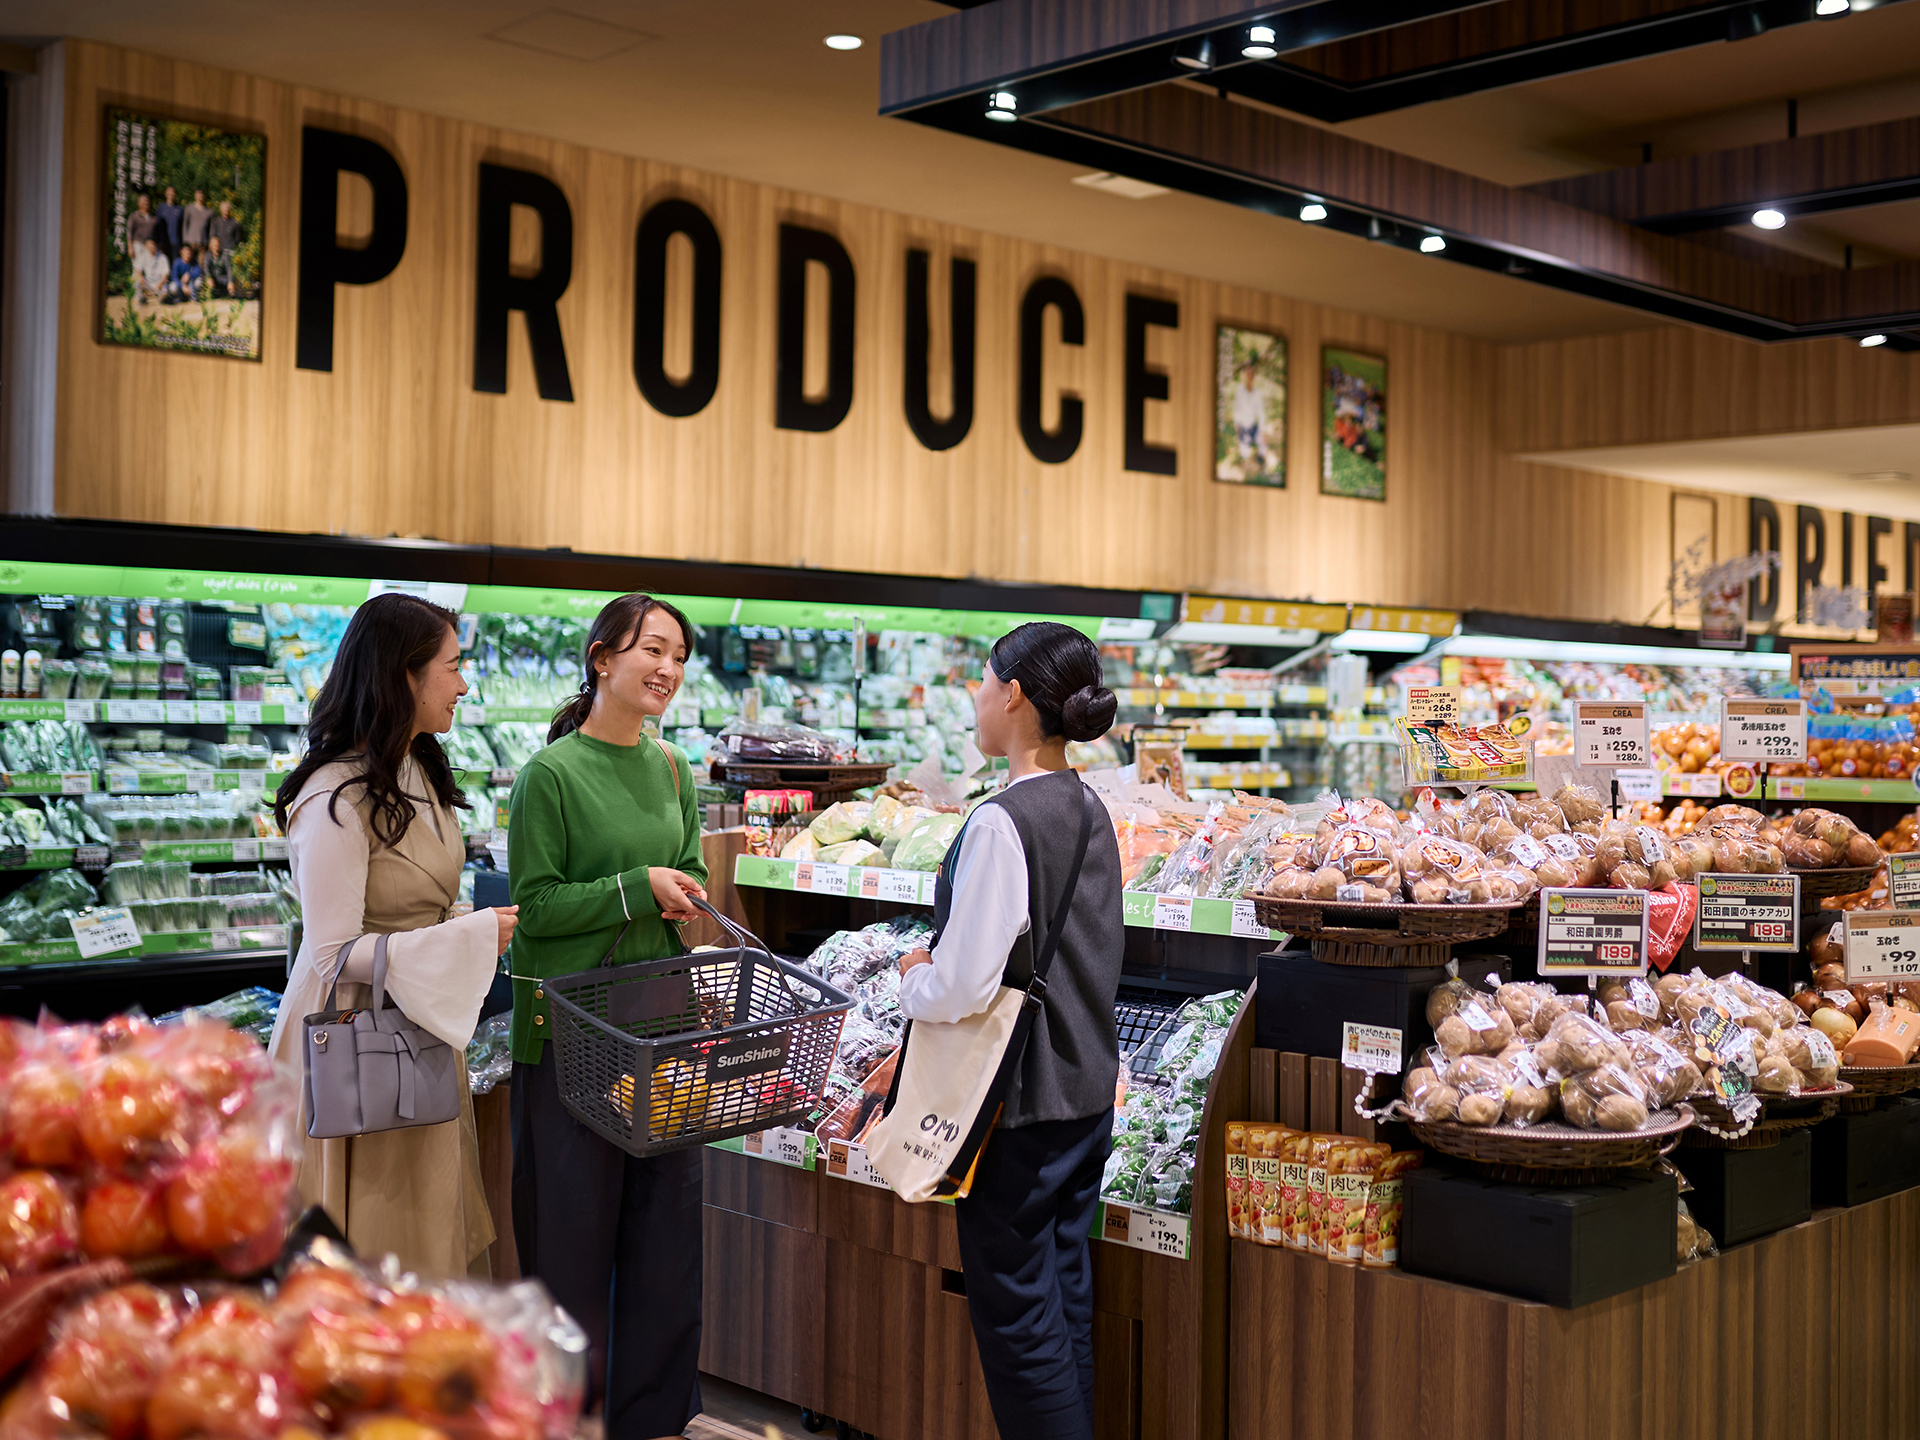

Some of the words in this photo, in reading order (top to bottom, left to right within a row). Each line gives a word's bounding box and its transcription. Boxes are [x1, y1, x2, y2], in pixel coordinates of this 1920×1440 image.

[295, 122, 1180, 477] PRODUCE
[1433, 704, 1452, 712] 268
[1612, 709, 1632, 717] CREA
[1602, 726, 1622, 735] 玉ねぎ
[1741, 722, 1787, 731] お徳用玉ねぎ
[1612, 740, 1636, 751] 259
[1763, 736, 1791, 746] 299
[1621, 753, 1637, 761] 280
[1773, 748, 1791, 756] 323
[863, 879, 878, 887] CREA
[1650, 894, 1678, 907] Shine
[1703, 906, 1790, 917] 和田農園のキタアカリ
[1173, 913, 1186, 921] 199
[1889, 918, 1913, 927] CREA
[1566, 926, 1623, 938] 和田農園男爵
[1755, 924, 1783, 936] 199
[1876, 936, 1900, 946] 玉ねぎ
[1603, 945, 1631, 959] 199
[1889, 950, 1917, 962] 99
[1900, 964, 1919, 973] 107
[1348, 1026, 1392, 1040] 肉じゃがのたれ
[717, 1047, 782, 1068] SunShine
[1376, 1048, 1391, 1058] 179
[783, 1143, 798, 1153] 299
[903, 1141, 912, 1153] by
[830, 1154, 847, 1165] CREA
[874, 1176, 885, 1184] 215
[1106, 1217, 1128, 1230] CREA
[1149, 1218, 1167, 1228] ピーマン
[1158, 1231, 1178, 1243] 199
[1163, 1243, 1177, 1253] 215
